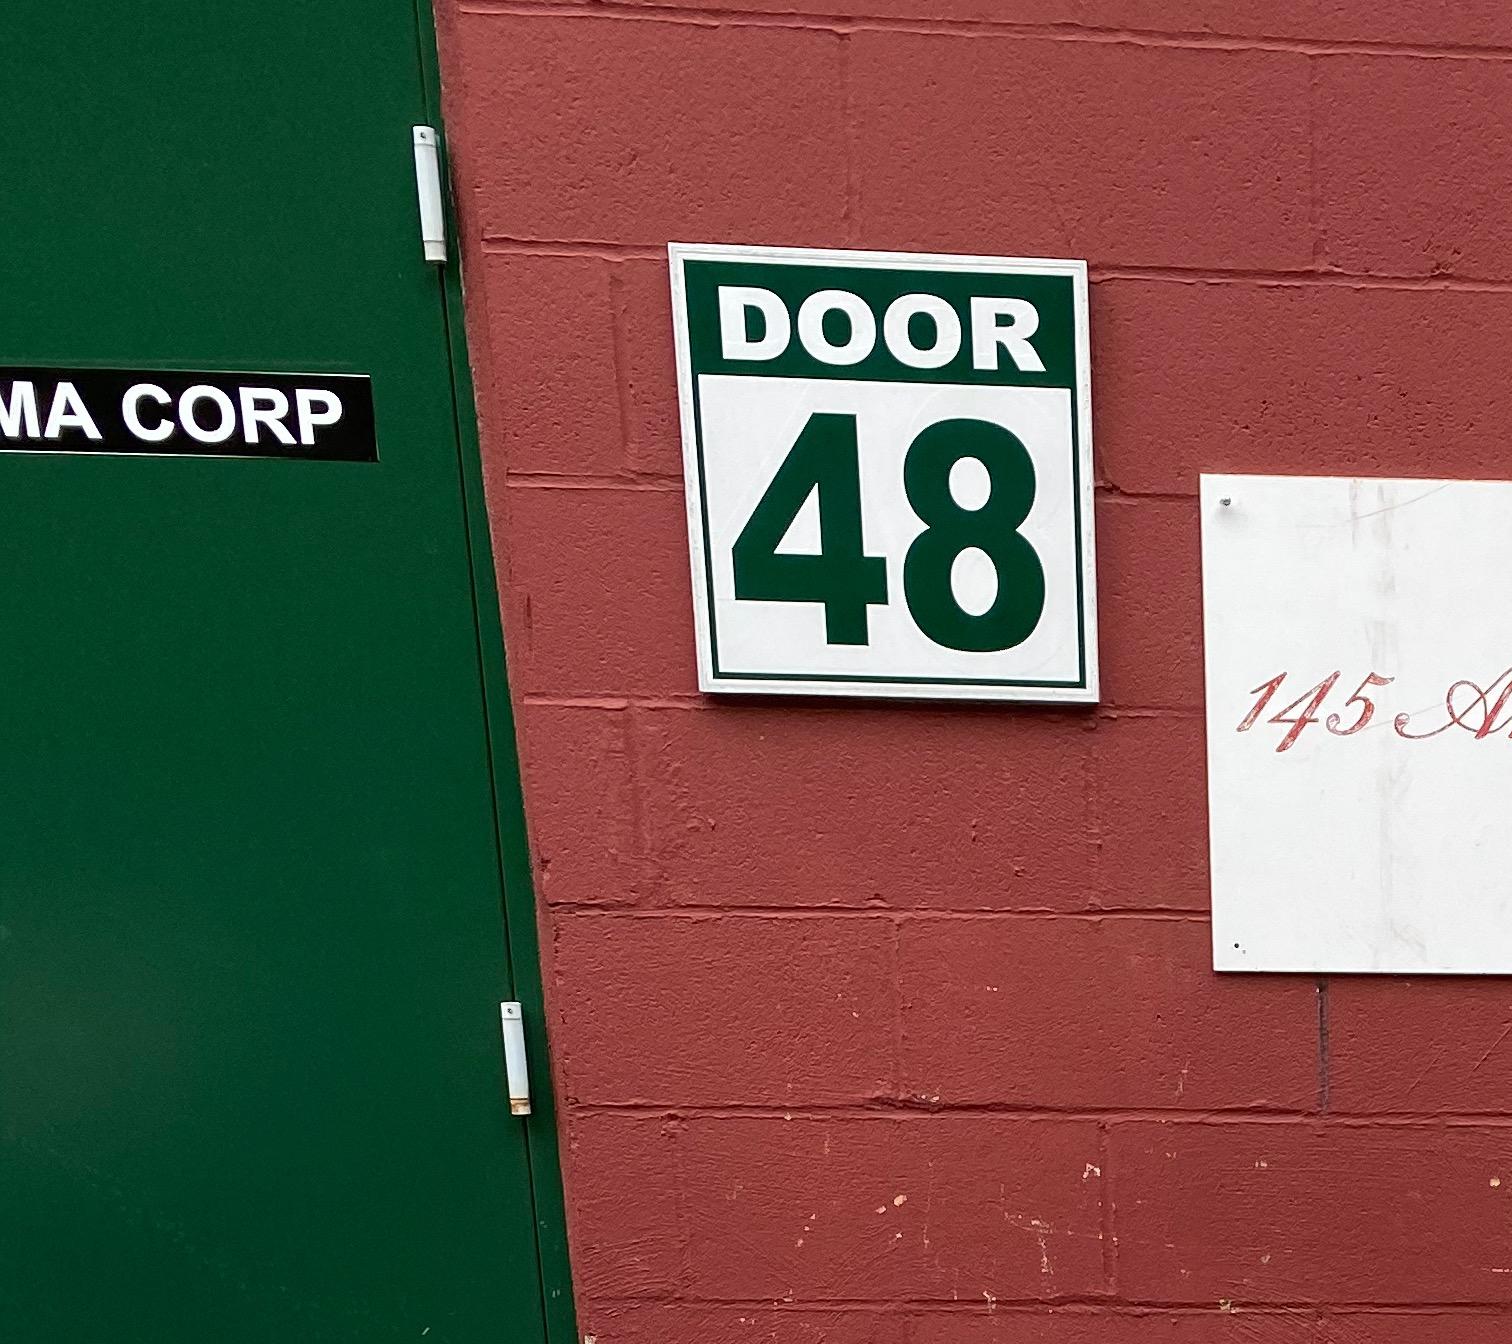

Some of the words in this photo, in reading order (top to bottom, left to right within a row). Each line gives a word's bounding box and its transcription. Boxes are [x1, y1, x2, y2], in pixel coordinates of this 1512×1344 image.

[717, 285, 1047, 372] DOOR
[0, 380, 103, 440] MA
[121, 383, 343, 445] CORP
[731, 412, 1046, 653] 48
[1236, 671, 1395, 753] 145
